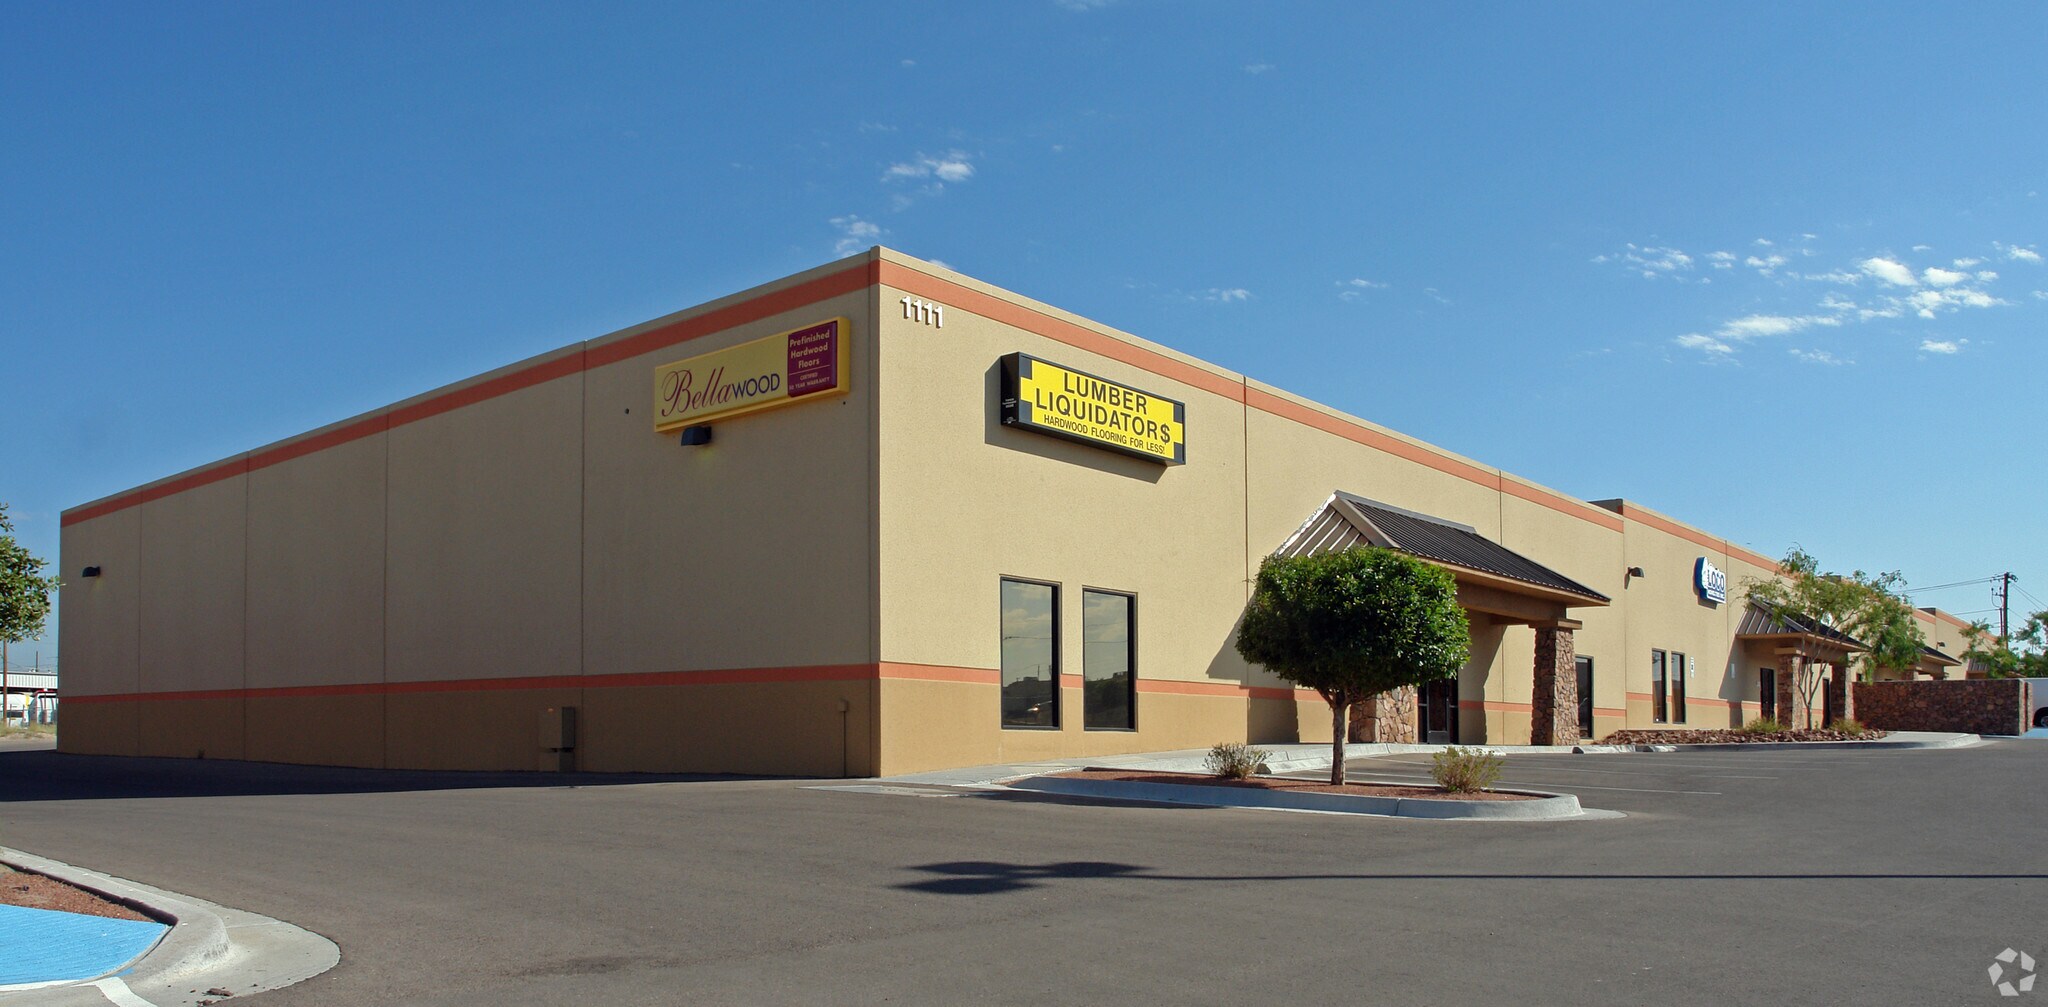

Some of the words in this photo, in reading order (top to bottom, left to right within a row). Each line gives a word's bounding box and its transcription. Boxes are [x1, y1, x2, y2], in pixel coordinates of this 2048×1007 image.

[900, 296, 943, 329] 1111
[790, 330, 830, 348] Prefinished
[791, 342, 828, 359] Hardwood
[798, 358, 820, 369] Floors
[1064, 372, 1147, 415] LUMBER
[1044, 414, 1088, 434] HARDWOOD
[1091, 427, 1127, 444] FLOORING
[1130, 437, 1144, 449] FOR
[1146, 442, 1165, 455] LESS!
[1707, 569, 1725, 591] LOCO
